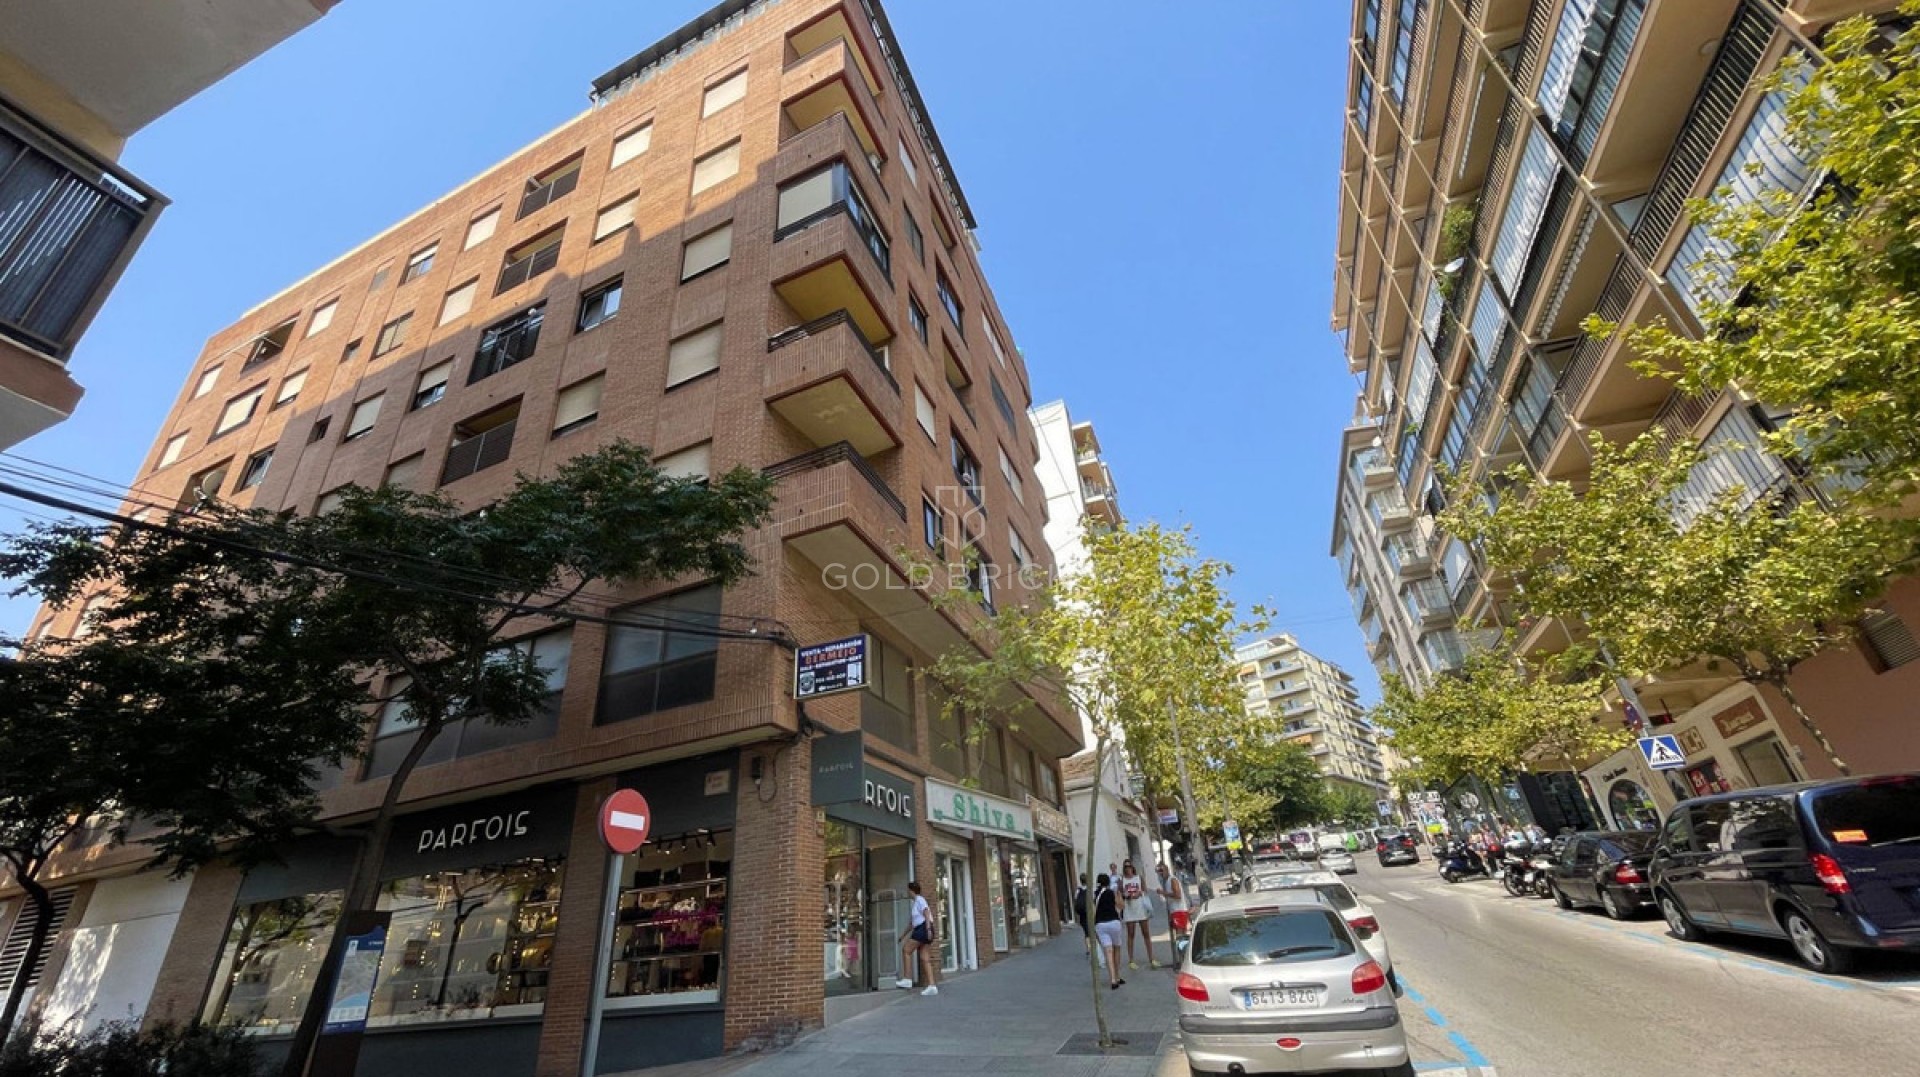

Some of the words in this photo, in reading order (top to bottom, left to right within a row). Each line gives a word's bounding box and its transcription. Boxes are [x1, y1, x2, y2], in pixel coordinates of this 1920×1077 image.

[864, 778, 911, 818] RFOIS
[952, 793, 1015, 831] Shiva
[417, 810, 530, 854] PARFOIS
[1251, 990, 1284, 1005] 6413
[1288, 989, 1315, 1004] BZG
